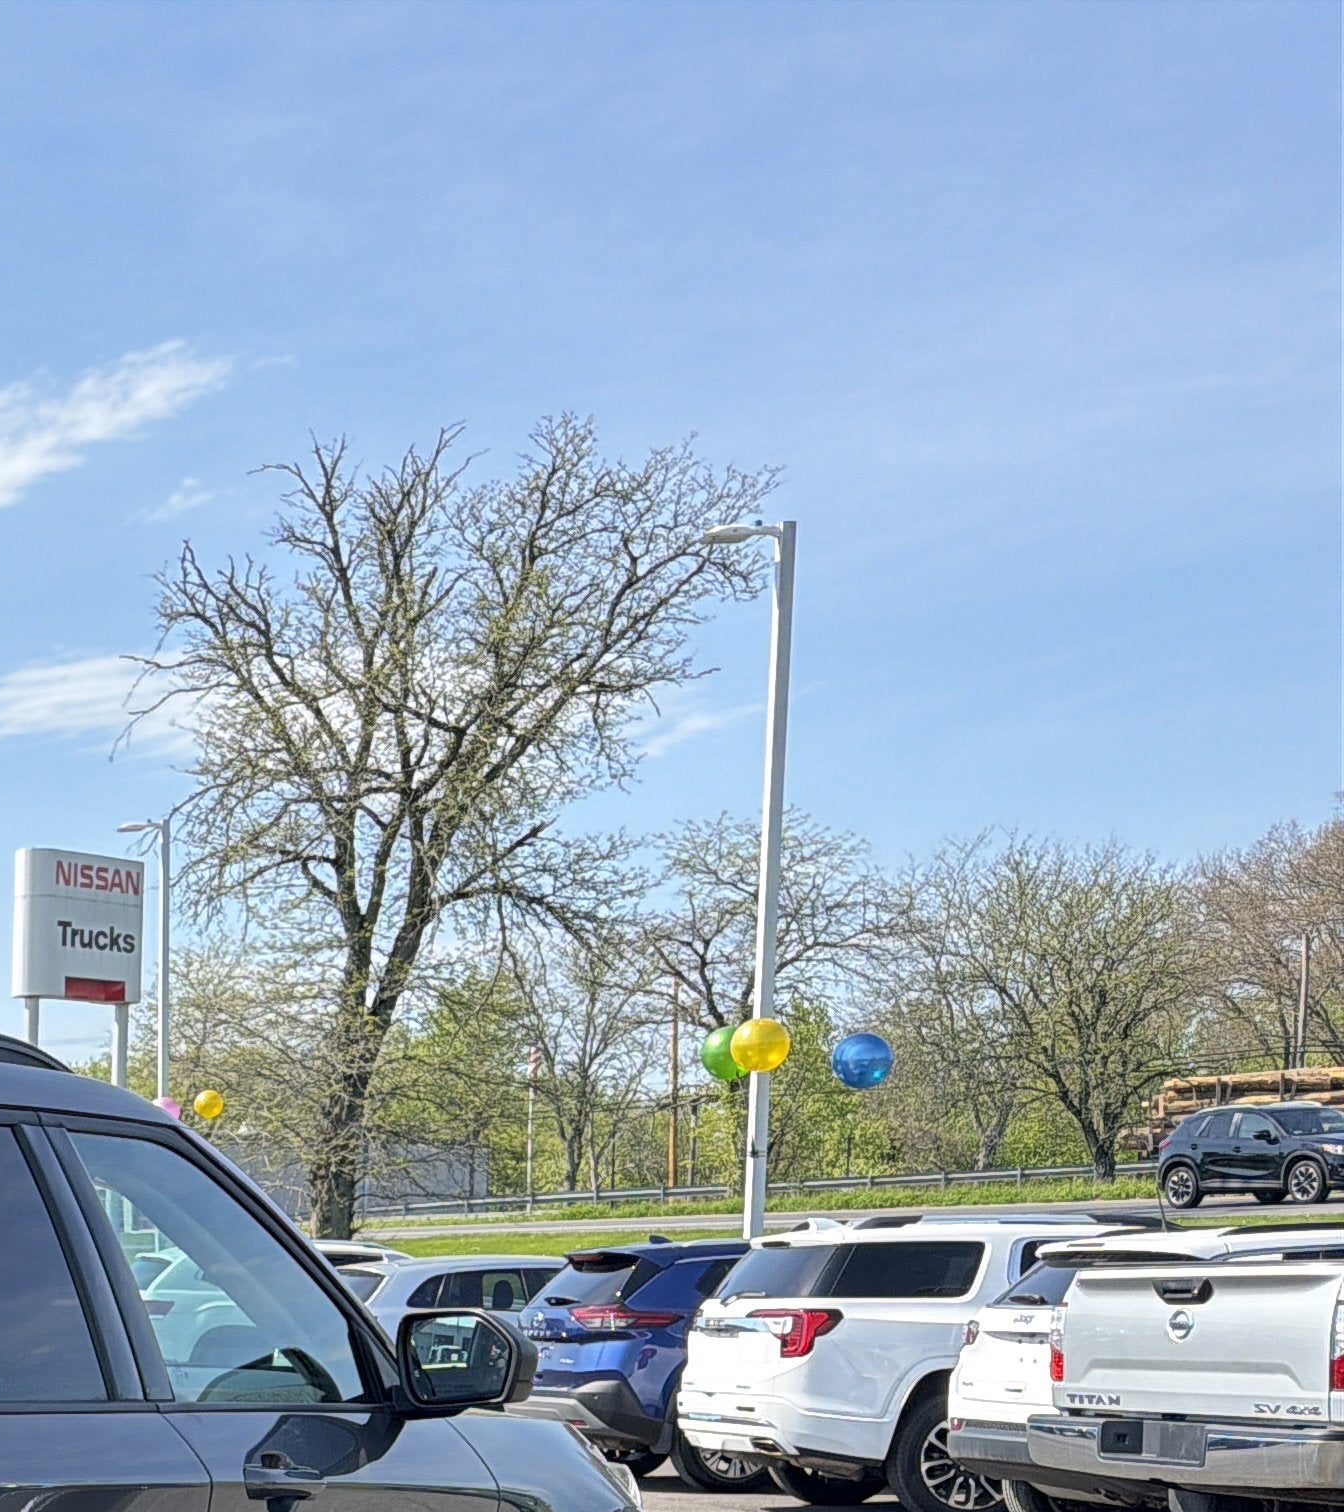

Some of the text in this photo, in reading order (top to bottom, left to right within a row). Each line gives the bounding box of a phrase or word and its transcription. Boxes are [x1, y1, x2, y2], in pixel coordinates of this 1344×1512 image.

[55, 860, 140, 896] NISSAN
[57, 920, 135, 954] Trucks
[1067, 1393, 1121, 1406] TITAN
[1253, 1403, 1281, 1414] SV
